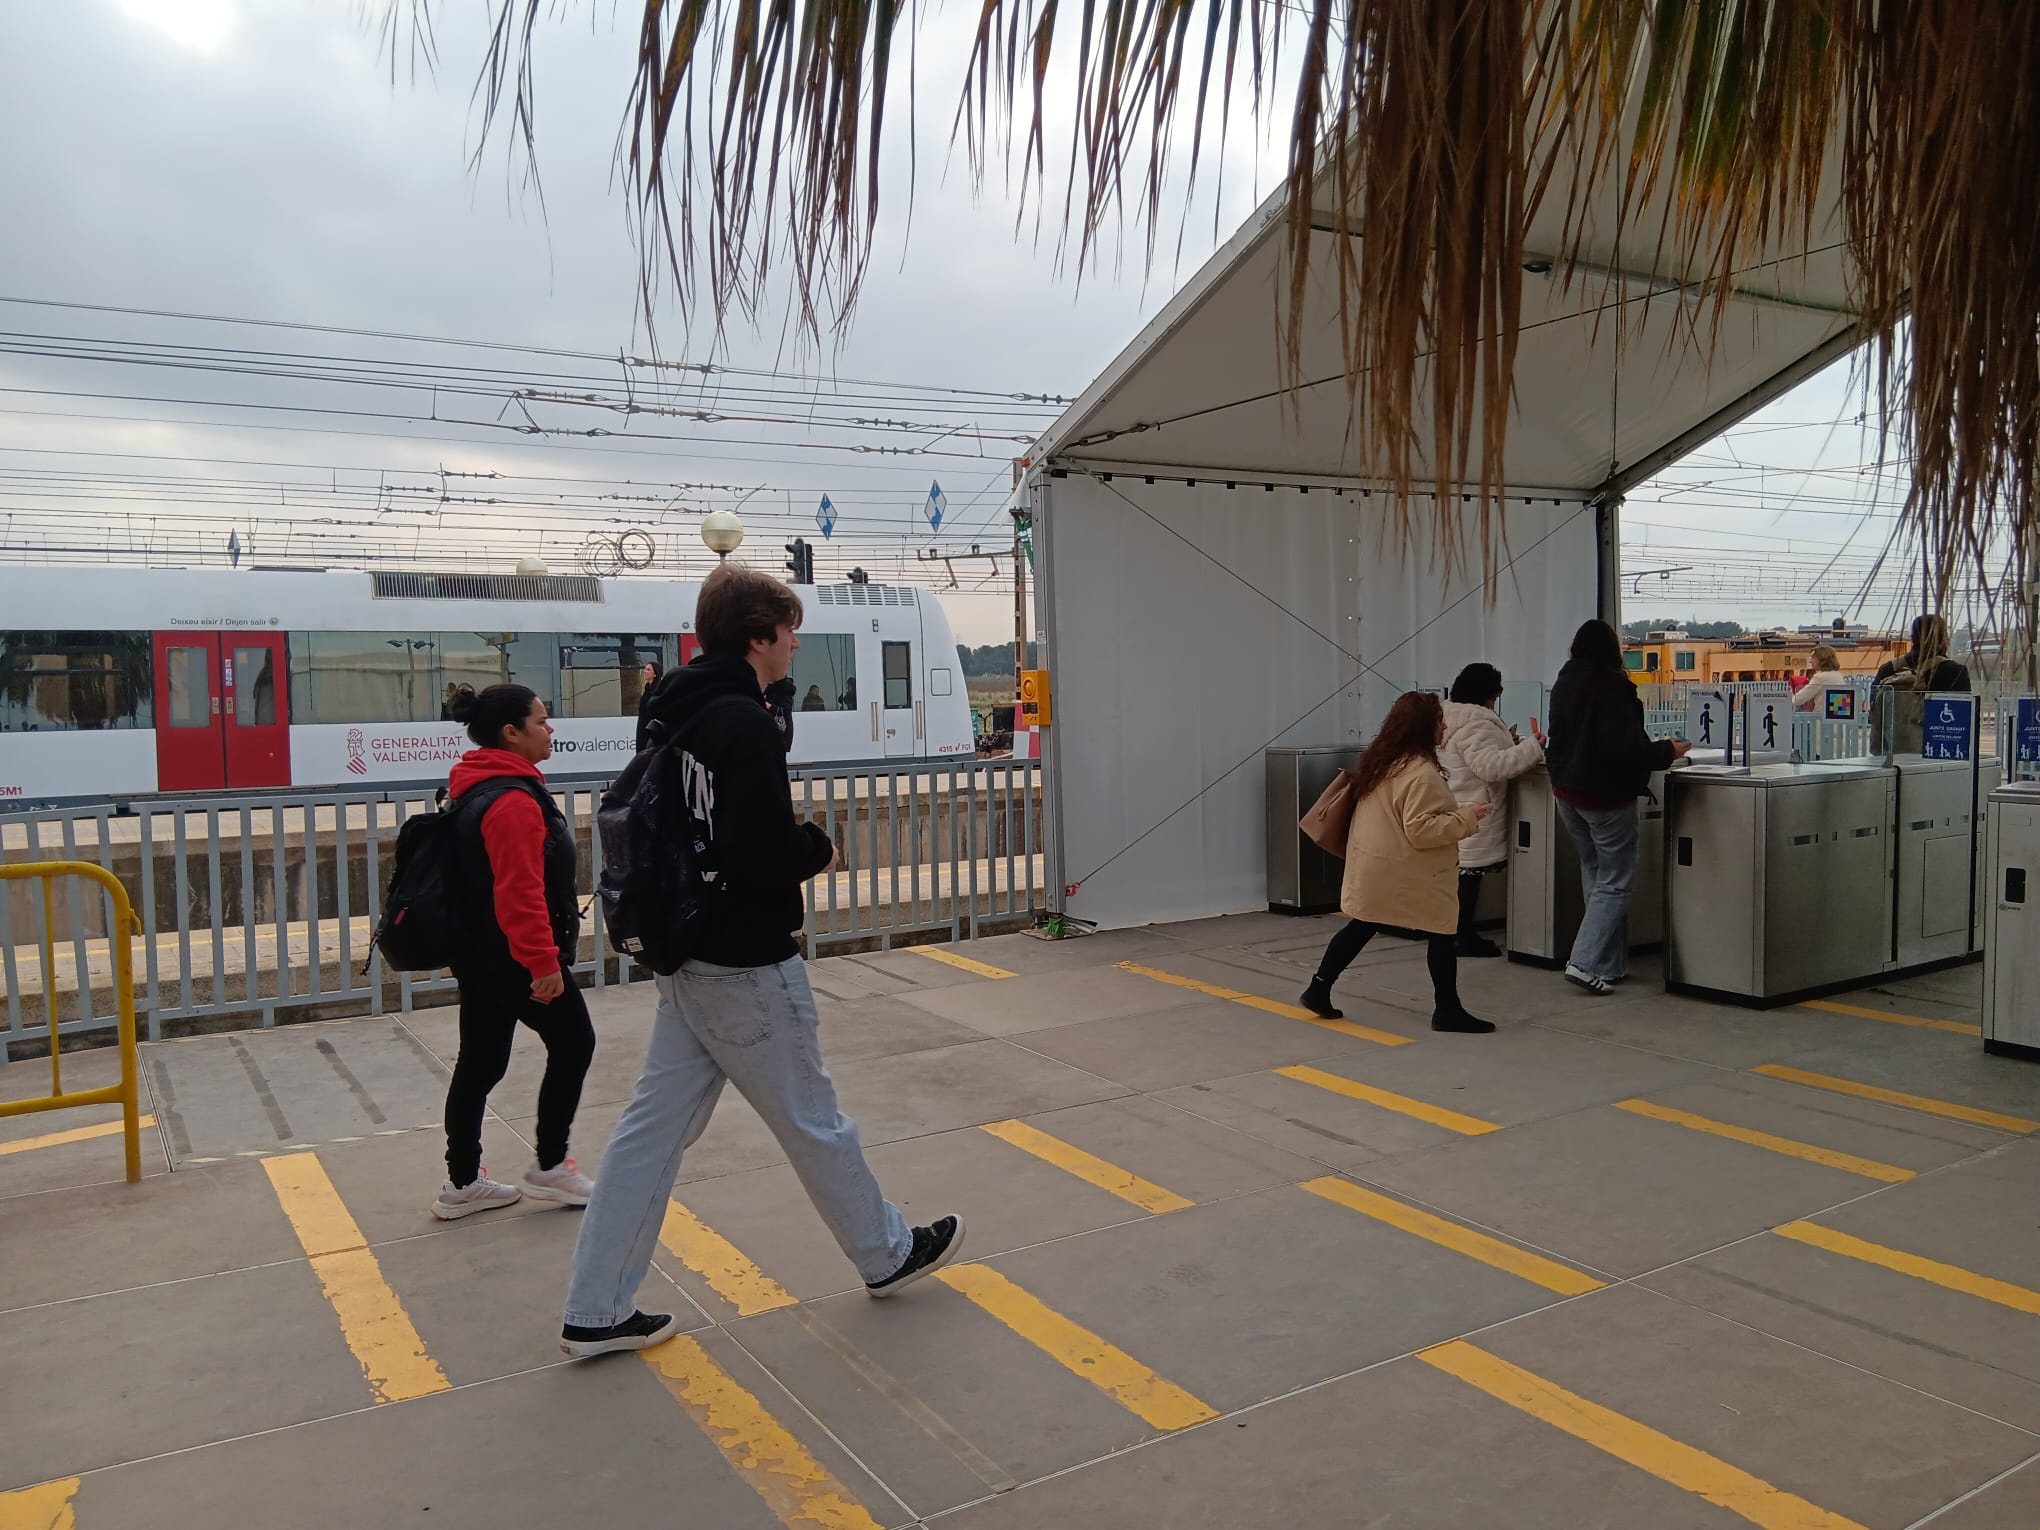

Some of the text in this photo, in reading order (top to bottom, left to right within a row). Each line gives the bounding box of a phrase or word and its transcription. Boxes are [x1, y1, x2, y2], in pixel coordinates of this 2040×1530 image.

[370, 735, 463, 750] GENERALITAT
[550, 736, 637, 753] trovalencia
[372, 748, 462, 763] VALENCIANA
